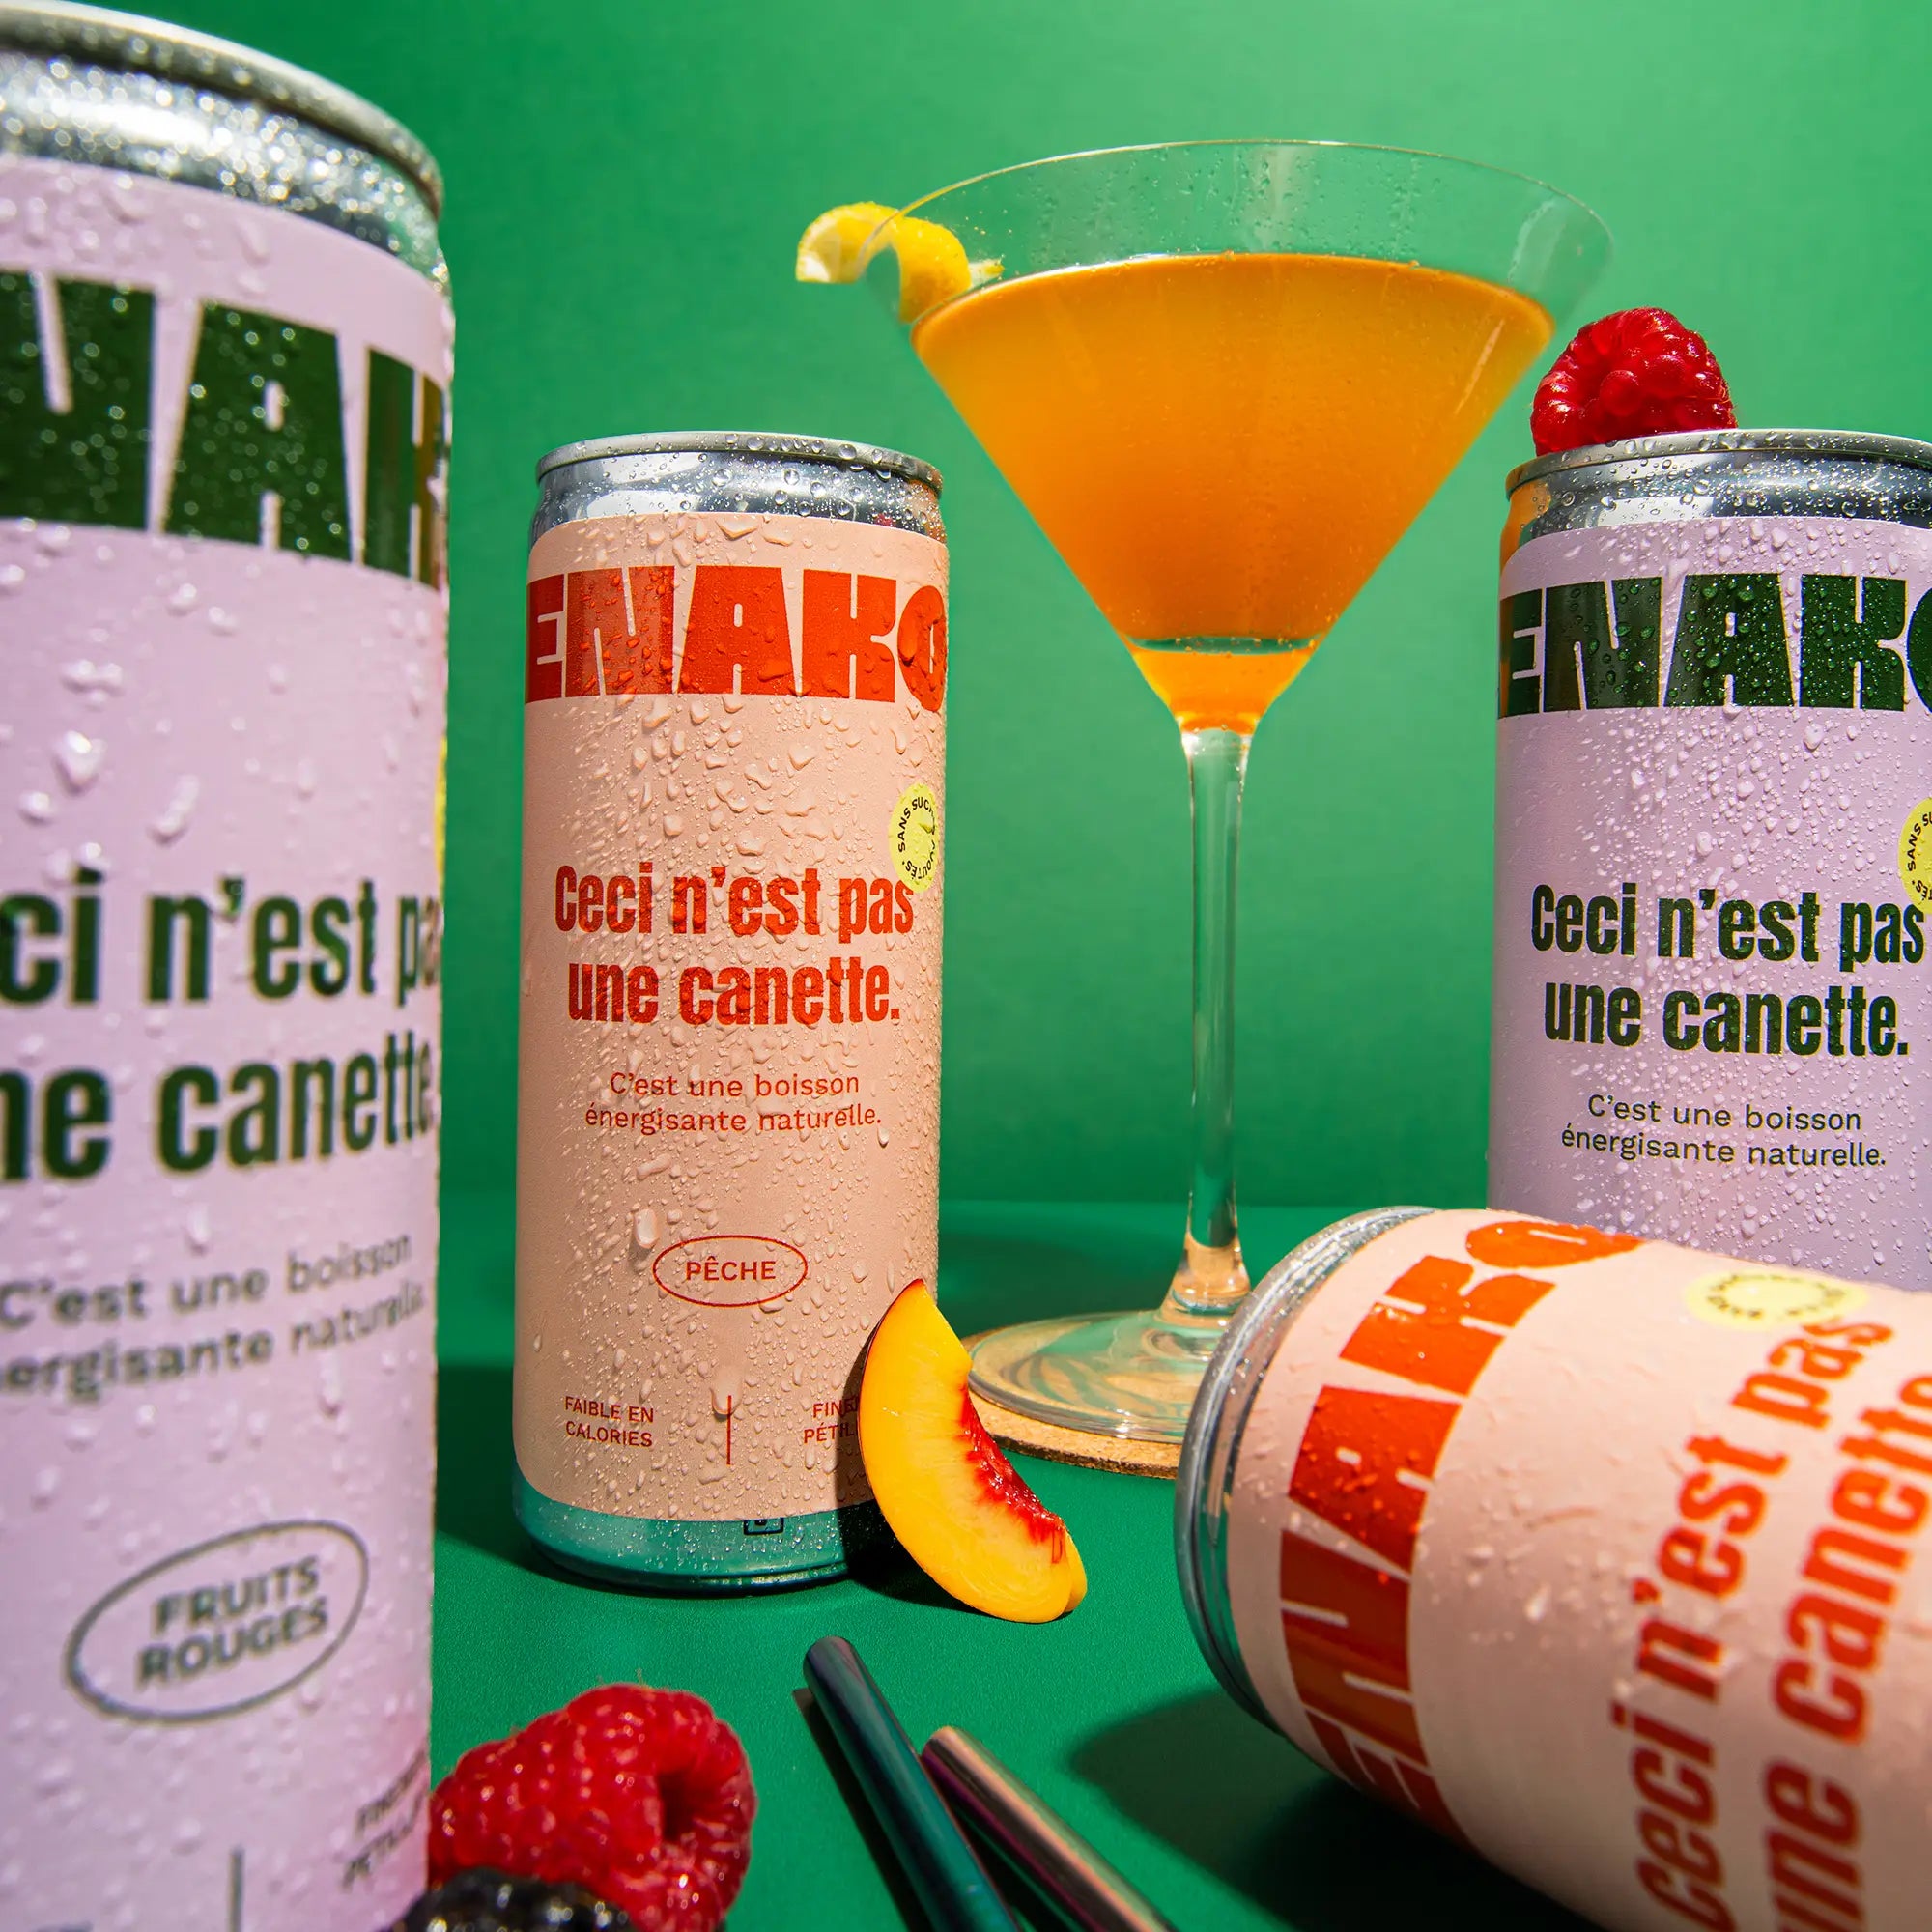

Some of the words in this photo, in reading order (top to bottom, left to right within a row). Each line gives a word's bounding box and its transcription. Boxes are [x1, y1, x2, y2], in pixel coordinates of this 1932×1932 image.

[526, 565, 947, 712] ENAKO
[897, 808, 911, 852] SANS
[1907, 823, 1921, 871] SANS
[554, 862, 653, 933] Ceci
[673, 866, 819, 935] n’est
[838, 877, 914, 944] pas
[1531, 882, 1636, 955] Ceci
[1657, 888, 1819, 962] n’est
[1839, 901, 1925, 972] pas
[568, 962, 659, 1023] une
[678, 956, 900, 1025] canette.
[1545, 981, 1642, 1047] une
[1662, 985, 1909, 1057] canette.
[610, 1071, 678, 1096] C’est
[690, 1073, 743, 1097] une
[754, 1074, 860, 1097] boisson
[1587, 1094, 1661, 1123] C’est
[1672, 1107, 1732, 1127] une
[1744, 1104, 1861, 1131] boisson
[585, 1102, 747, 1136] énergisante
[758, 1104, 882, 1132] naturelle.
[1561, 1123, 1735, 1160] énergisante
[1747, 1142, 1888, 1167] naturelle.
[171, 1267, 269, 1316] une
[288, 1235, 411, 1294] boisson
[685, 1256, 777, 1282] PÊCHE
[565, 1396, 621, 1420] FAIBLE
[628, 1406, 654, 1423] EN
[566, 1421, 653, 1447] CALORIES
[156, 1555, 320, 1634] FRUITS
[137, 1598, 327, 1687] ROUGES
[1610, 1698, 1737, 1932] Ceci
[1730, 1320, 1897, 1431] pas
